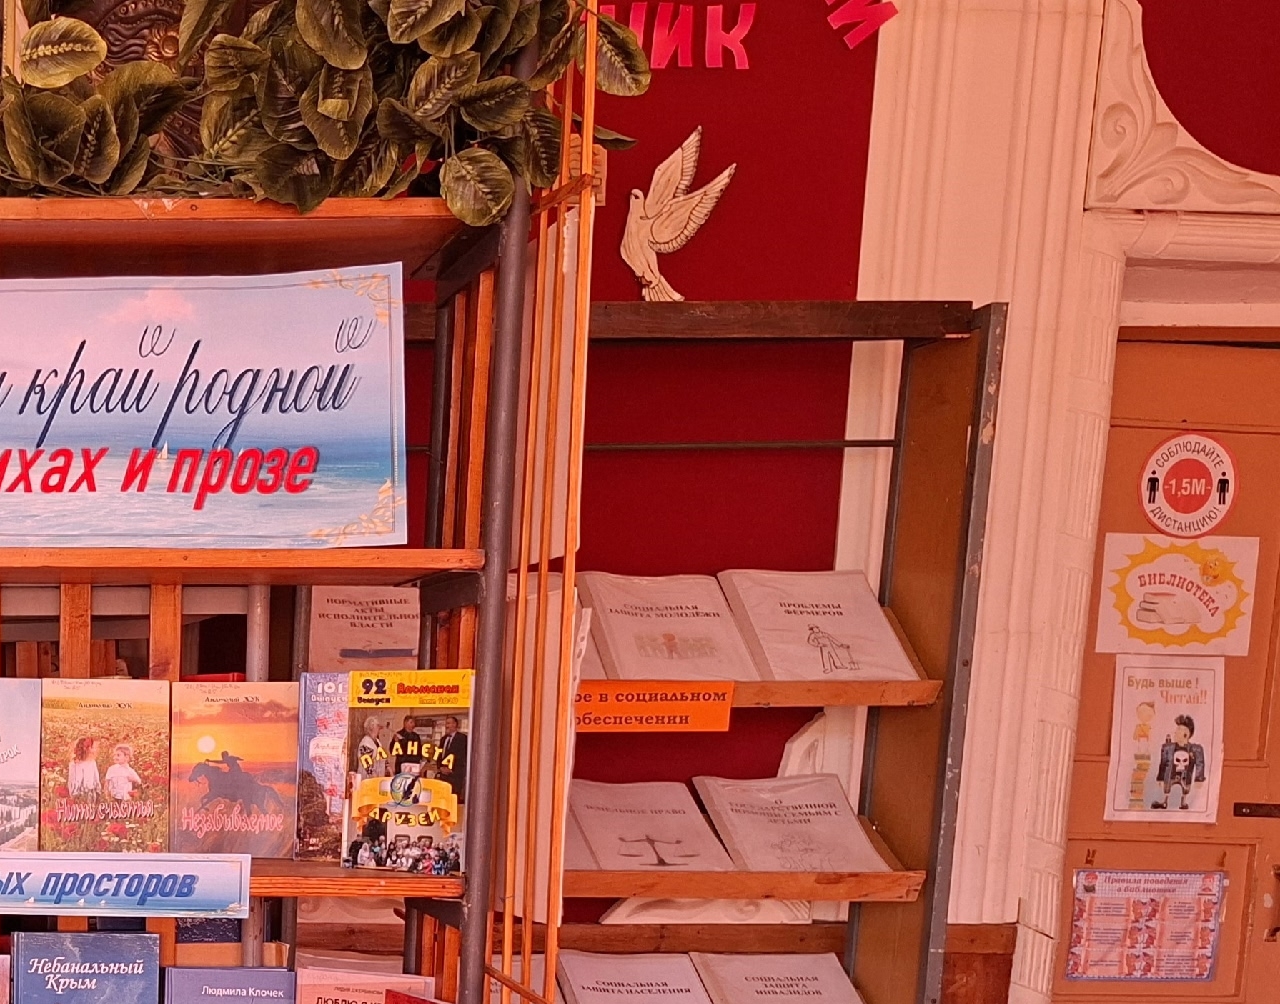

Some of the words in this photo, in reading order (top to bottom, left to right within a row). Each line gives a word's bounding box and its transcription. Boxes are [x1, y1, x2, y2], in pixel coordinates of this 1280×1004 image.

[17, 323, 172, 448] край
[157, 317, 375, 452] родной
[1156, 441, 1224, 469] СОБЛЮДАЙТЕ
[120, 445, 161, 493] и
[166, 443, 320, 511] прозе
[1150, 506, 1222, 532] ДИСТАНЦИЮ!
[326, 598, 411, 606] НОРМАТИВНЫЕ
[1138, 573, 1220, 617] БИБЛИОТЕКА
[361, 678, 387, 695] 92
[396, 682, 460, 695] Альманах
[1127, 675, 1155, 691] Будь
[1159, 677, 1192, 688] выше
[598, 692, 609, 702] в
[614, 690, 727, 703] социальном
[360, 740, 455, 770] ПЛАНЕТА
[181, 802, 285, 840] Незабываемое
[40, 871, 197, 906] просторов
[28, 956, 144, 975] Небанальный
[45, 973, 97, 995] Крым
[201, 985, 247, 998] Людмила
[248, 986, 285, 999] Клочек
[595, 979, 669, 988] СОЦИАЛЬНАЯ
